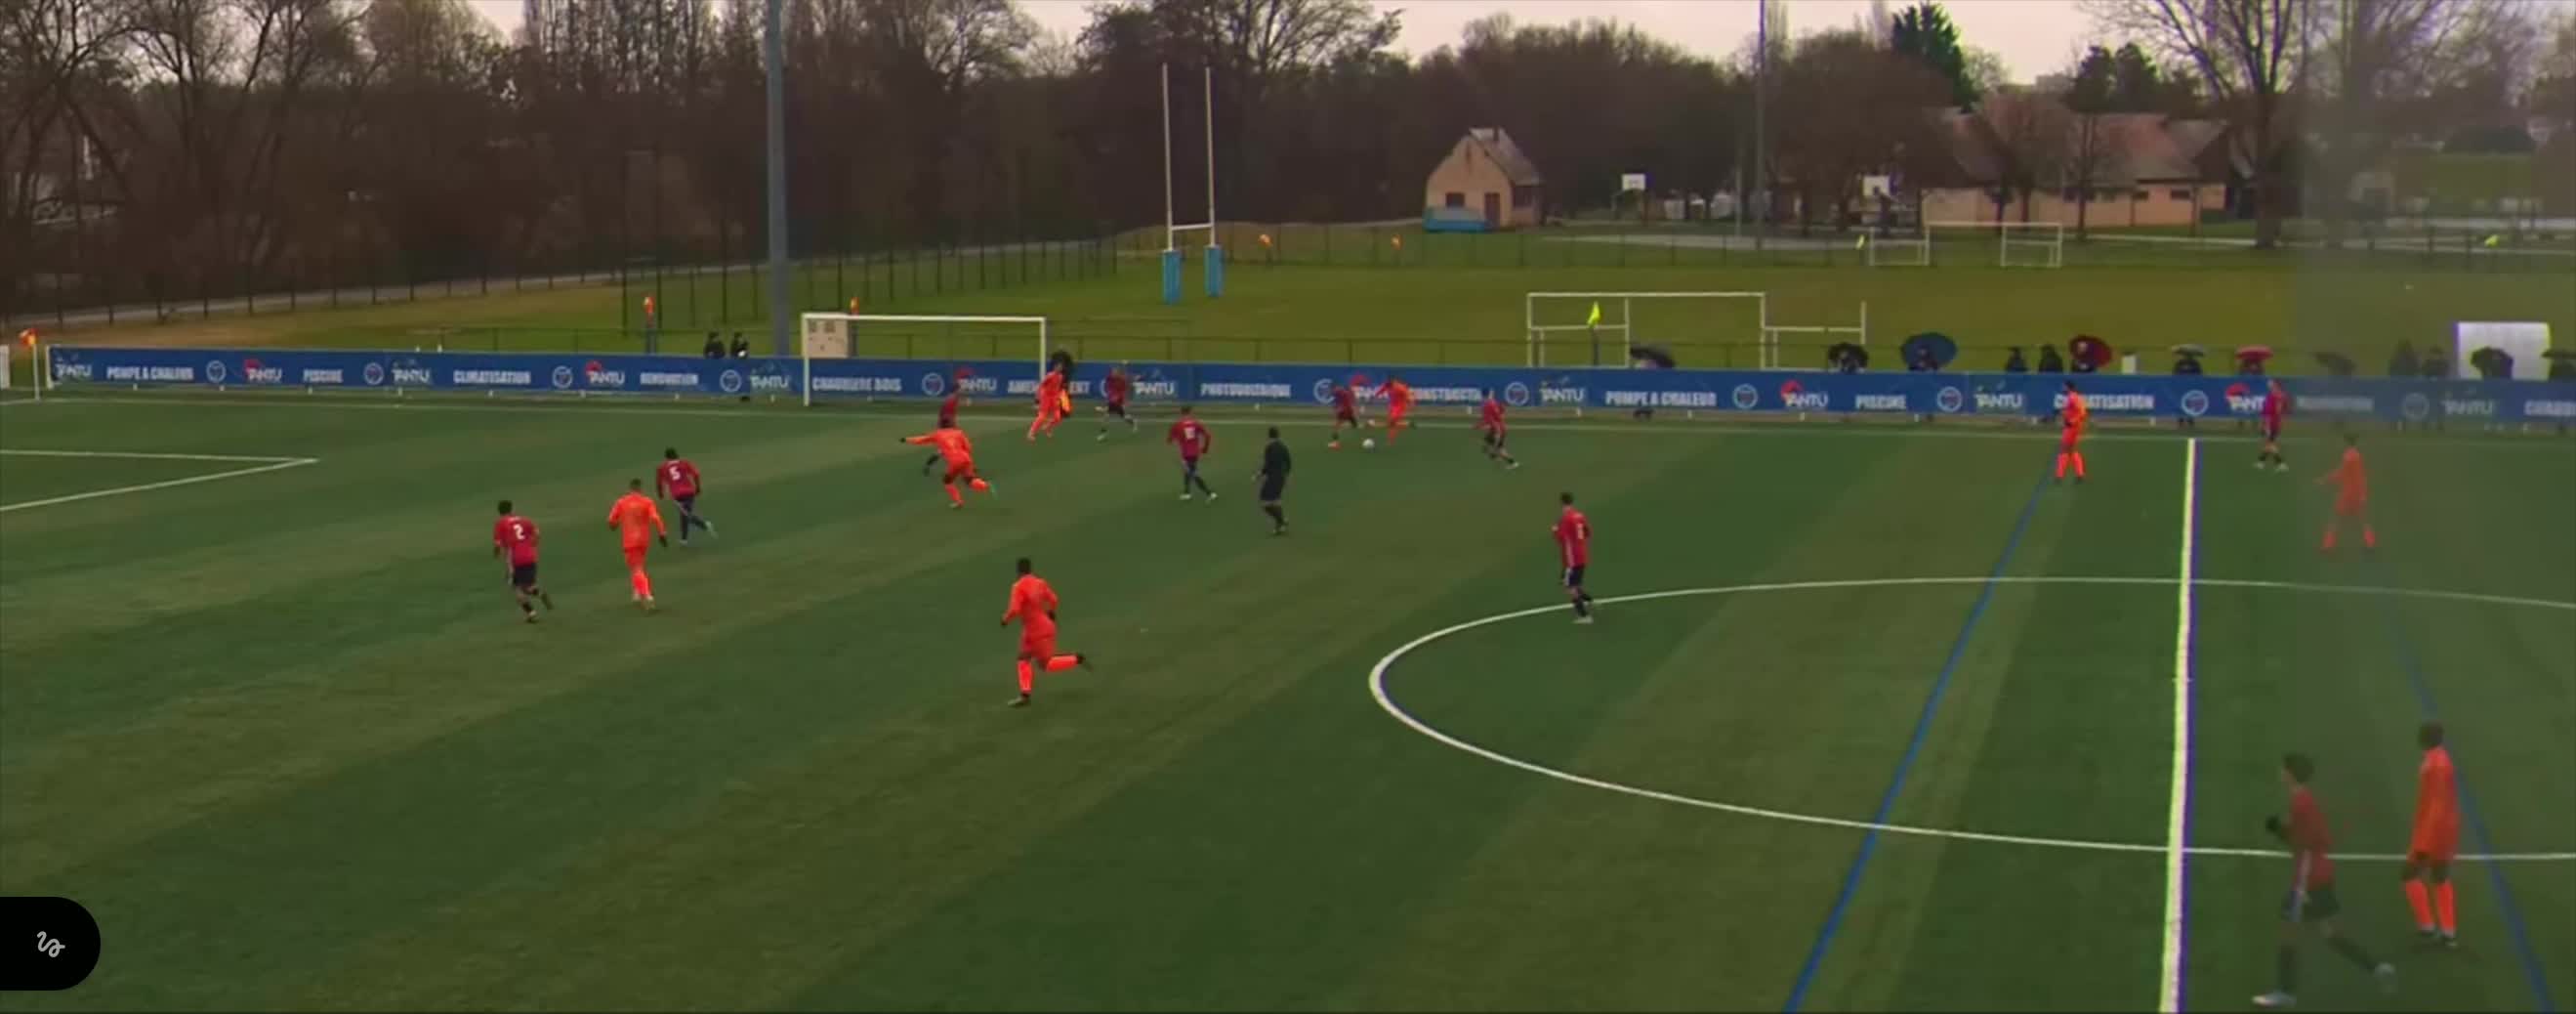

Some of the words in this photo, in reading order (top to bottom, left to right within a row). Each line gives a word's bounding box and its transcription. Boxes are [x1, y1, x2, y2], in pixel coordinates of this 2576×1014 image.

[453, 370, 531, 385] CLIMATISATION
[1660, 391, 1718, 407] CHALEUR
[1974, 393, 2022, 408] TANTU
[2225, 395, 2267, 411] TANT
[668, 465, 682, 481] 5
[513, 523, 525, 540] 2
